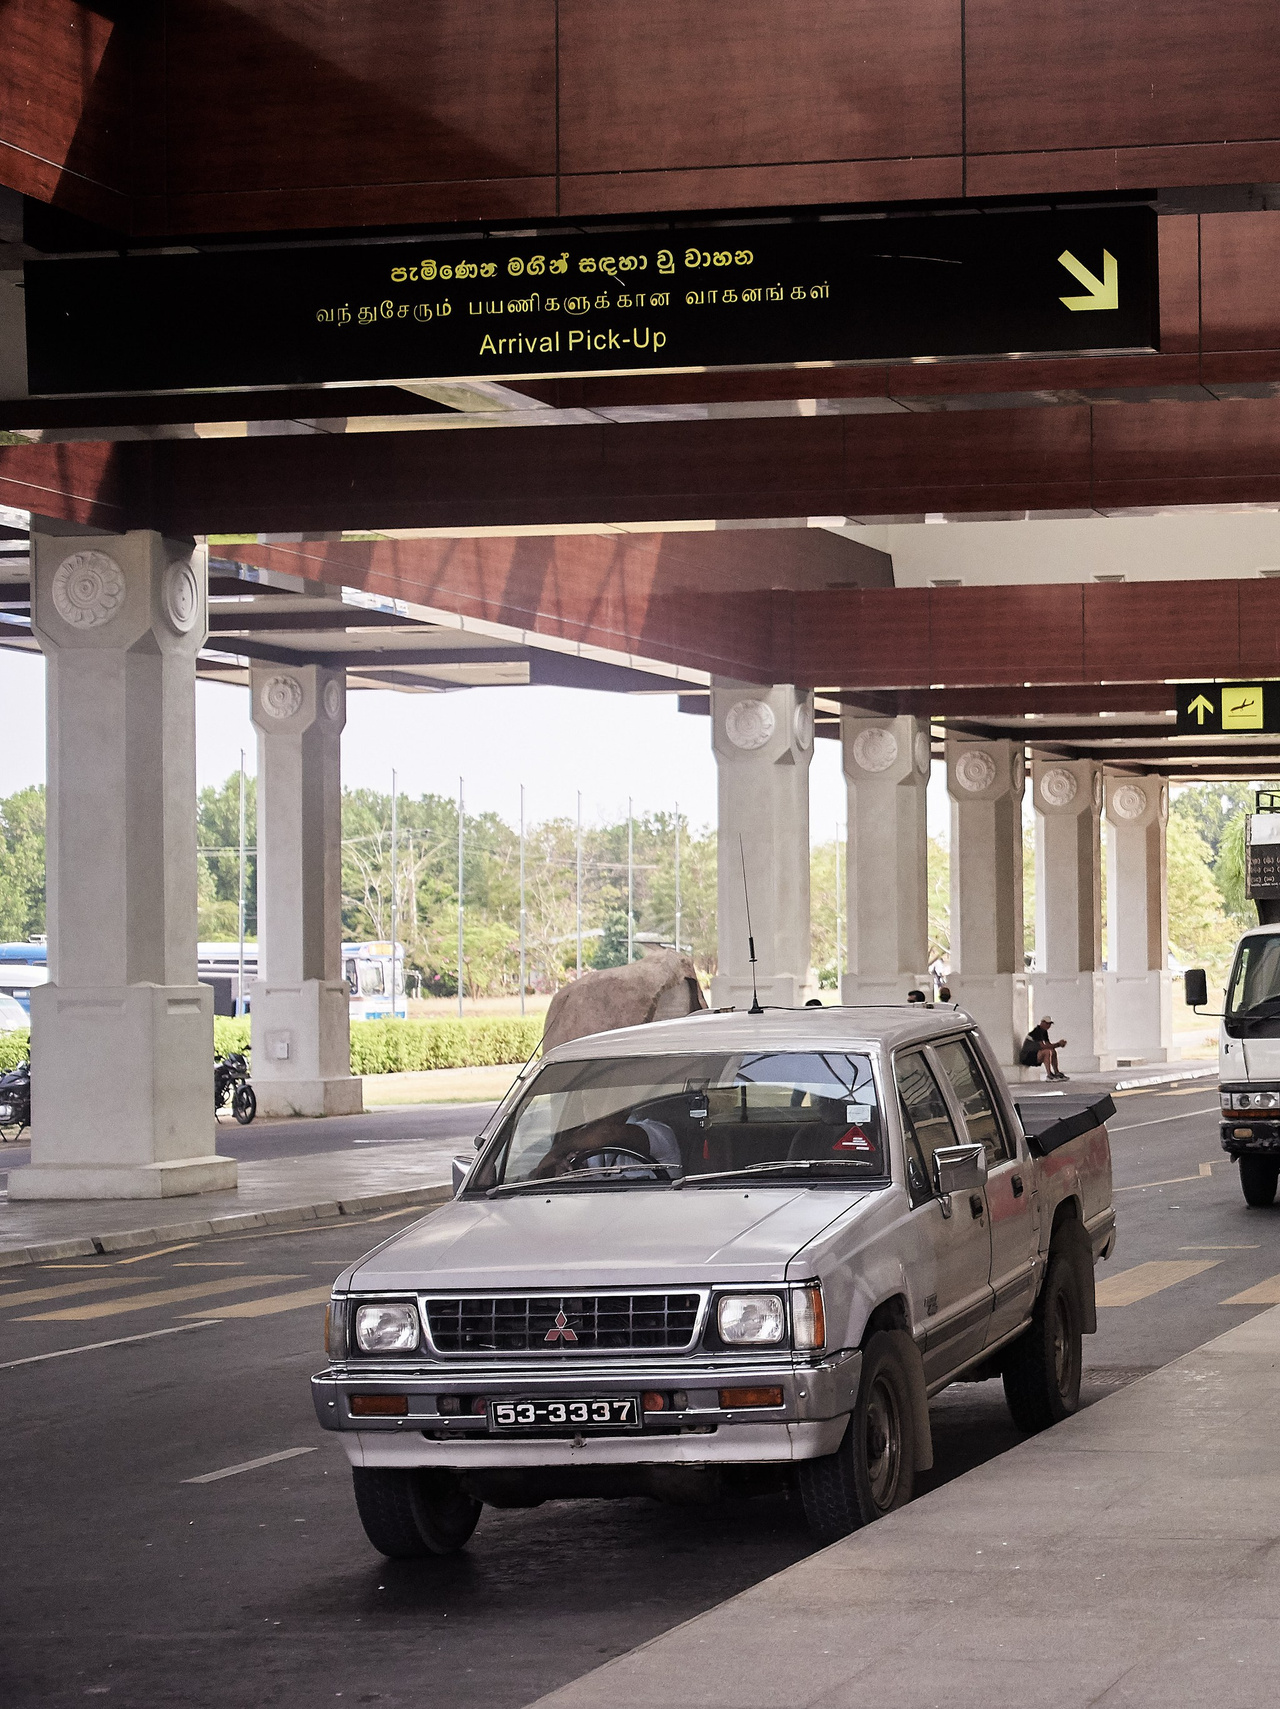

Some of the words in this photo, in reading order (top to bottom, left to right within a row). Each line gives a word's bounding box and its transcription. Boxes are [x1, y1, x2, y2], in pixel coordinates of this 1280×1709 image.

[578, 255, 648, 276] සඳහා
[684, 248, 754, 268] වාහන
[479, 331, 560, 355] Arrival
[568, 327, 667, 352] Pick-Up
[496, 1402, 631, 1424] 53-3337
